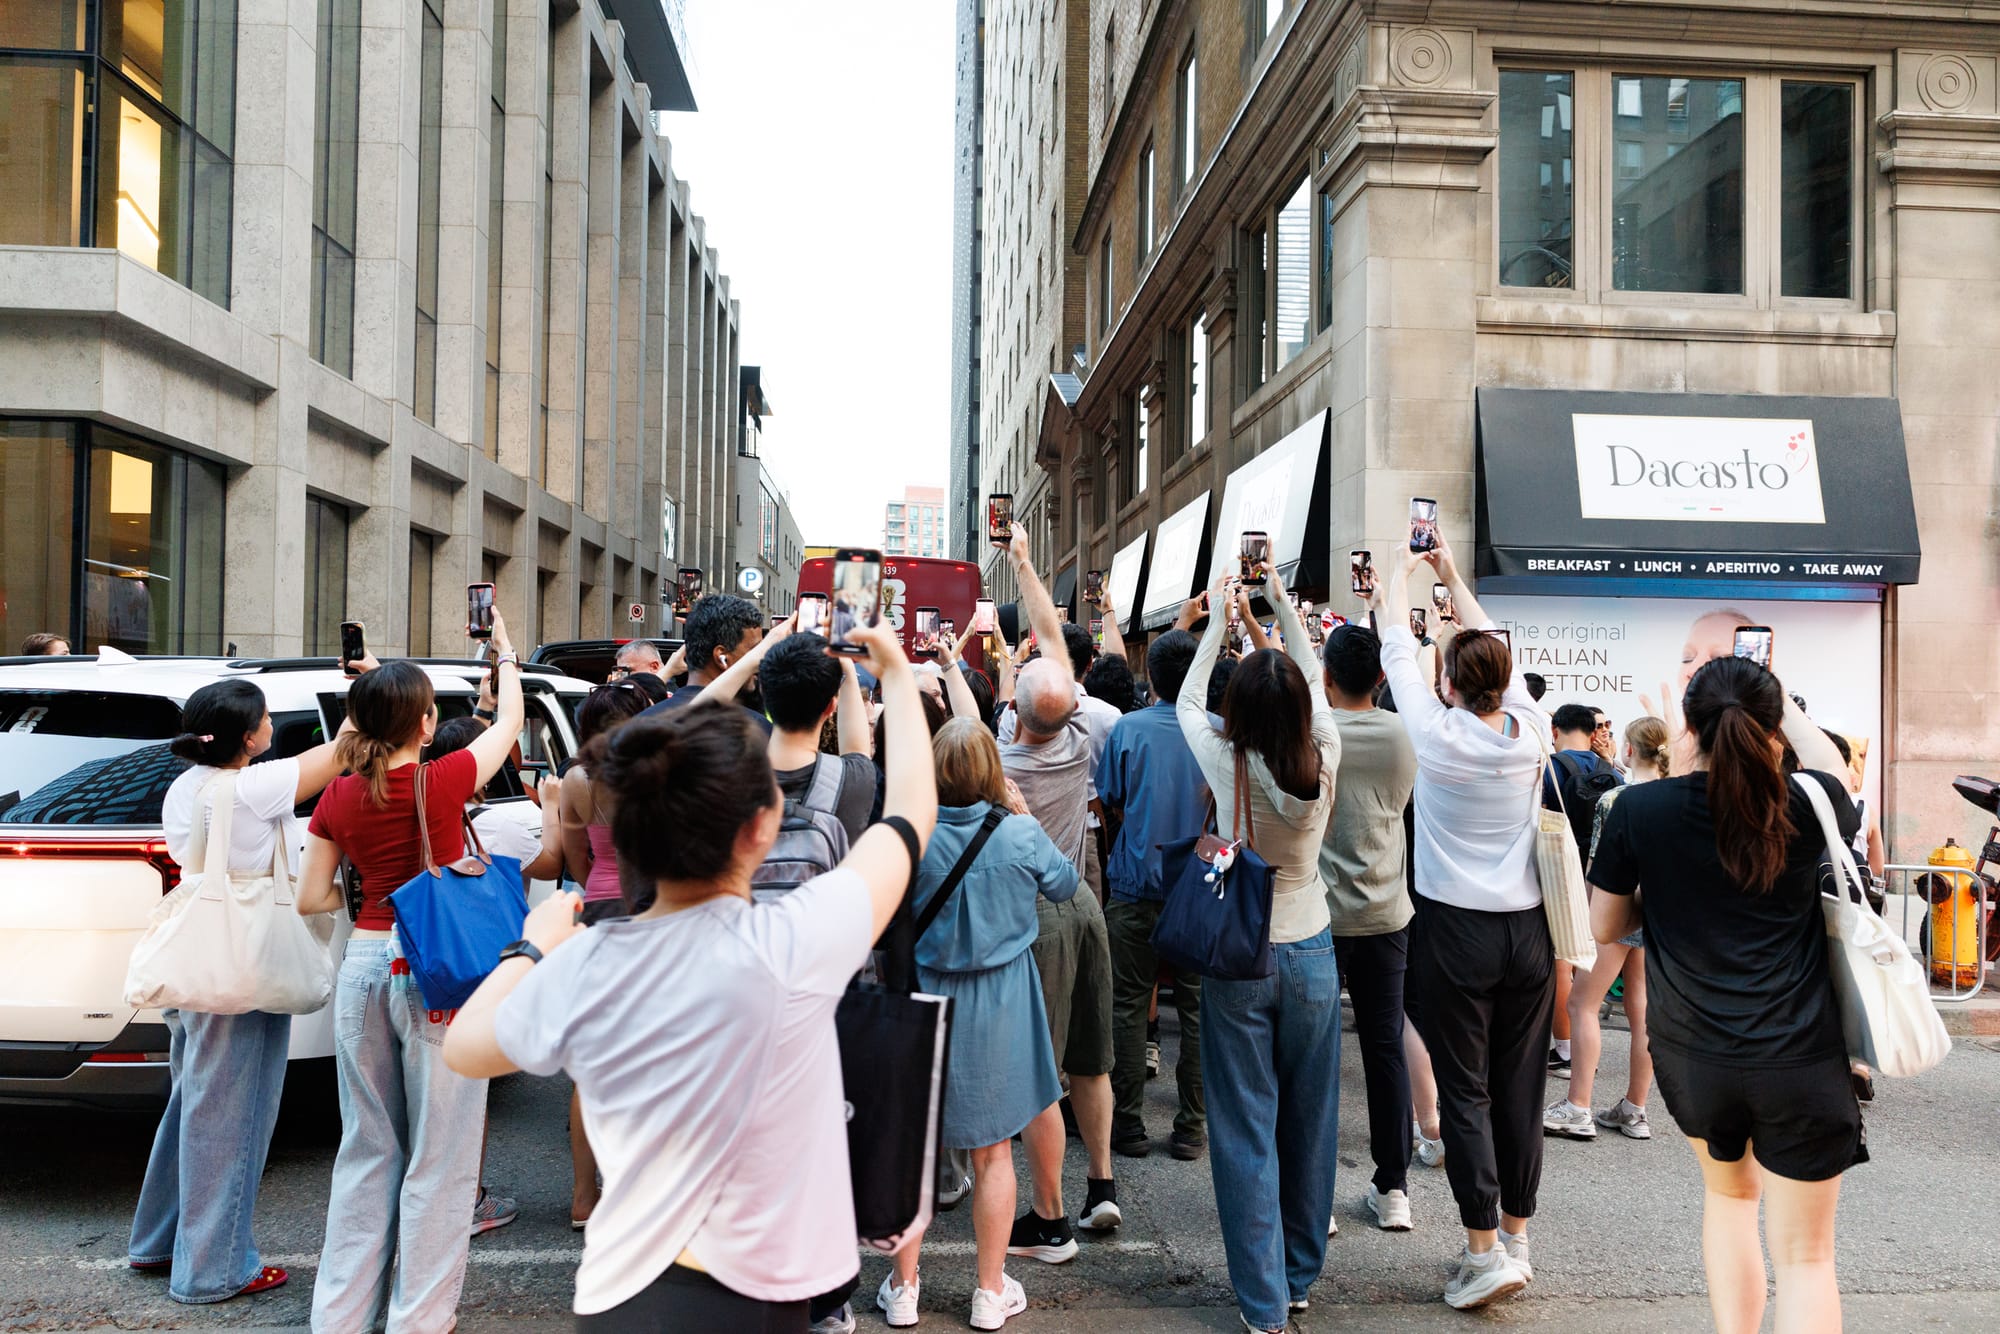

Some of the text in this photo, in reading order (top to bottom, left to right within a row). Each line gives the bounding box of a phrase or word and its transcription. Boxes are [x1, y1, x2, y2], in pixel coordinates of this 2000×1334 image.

[1606, 445, 1789, 490] Dacasto
[1527, 559, 1883, 576] BREAKFAST LUNCH APERITIVO TAKE AWAY
[745, 572, 757, 587] P
[1500, 621, 1626, 643] The original
[1519, 647, 1608, 666] ITALIAN
[1542, 674, 1633, 693] ETTONE
